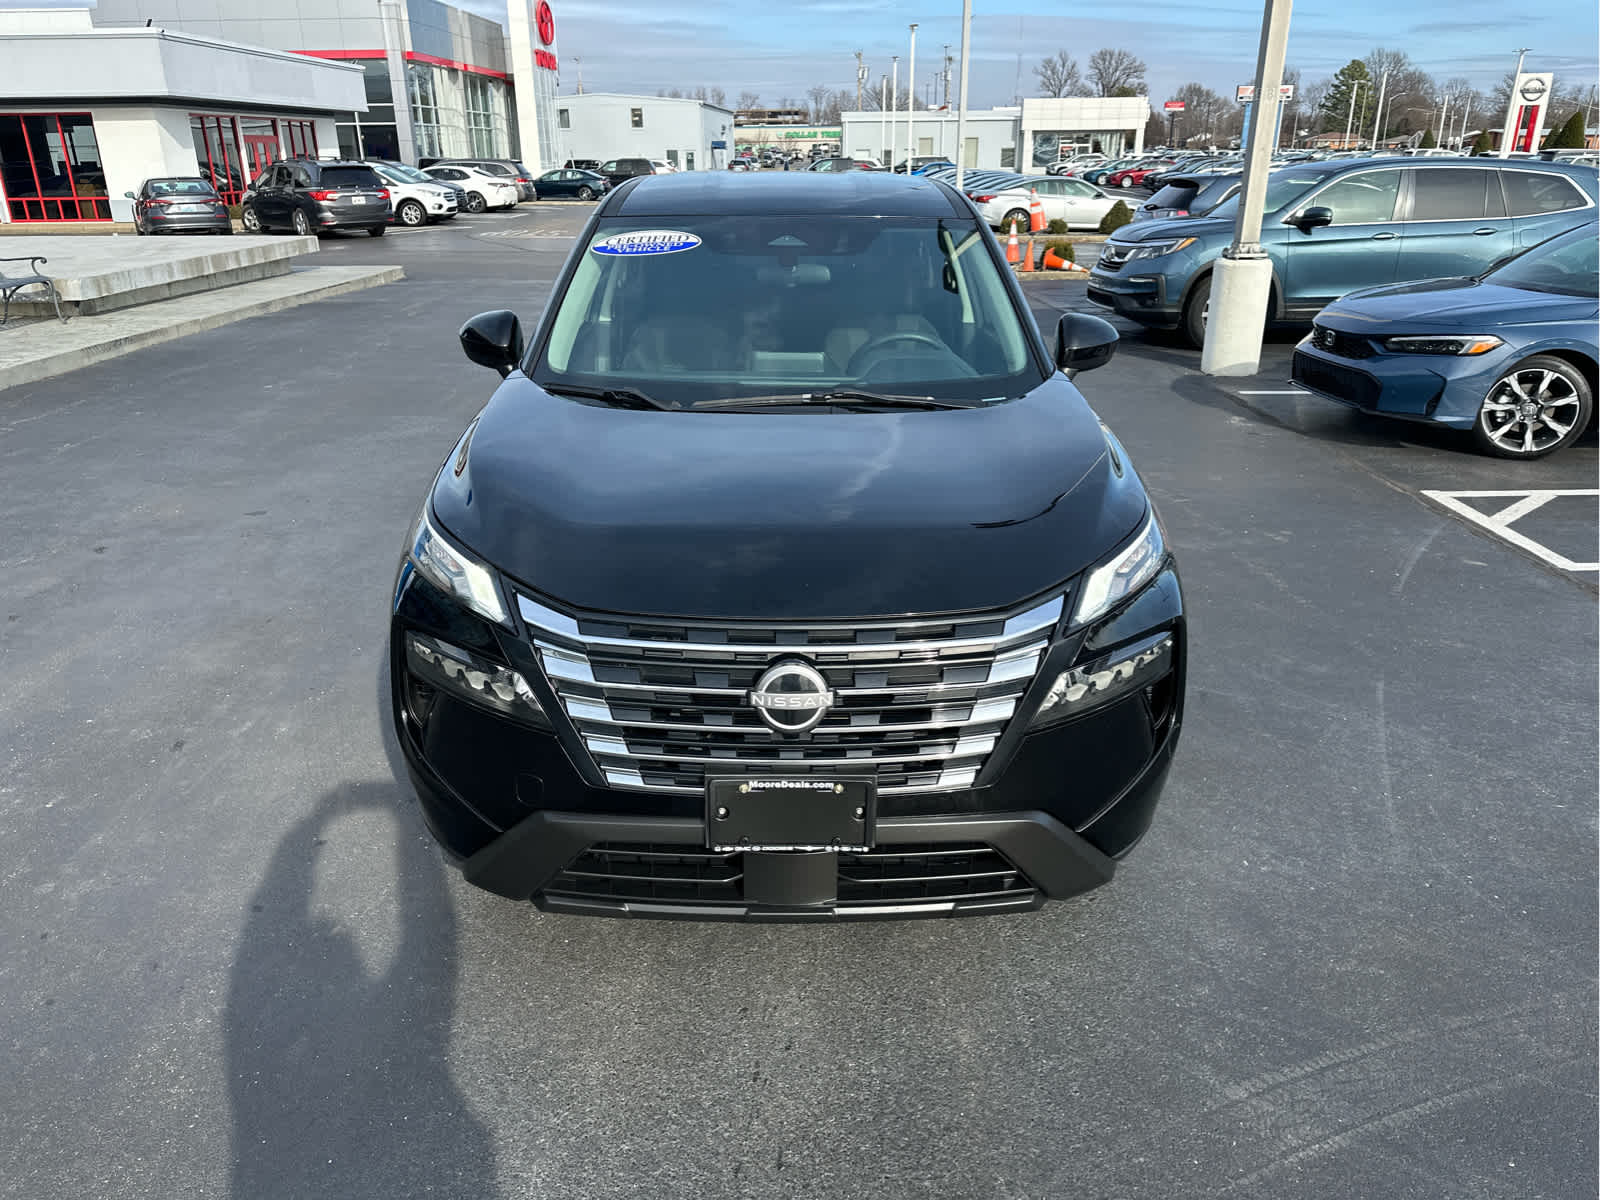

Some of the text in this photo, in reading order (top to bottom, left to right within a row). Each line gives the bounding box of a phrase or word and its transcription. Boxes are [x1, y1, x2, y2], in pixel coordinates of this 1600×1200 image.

[606, 234, 690, 245] CERTIFIED
[617, 245, 671, 254] VEHICLE
[751, 694, 834, 707] NISSAN
[748, 780, 834, 790] MooreDeals.com
